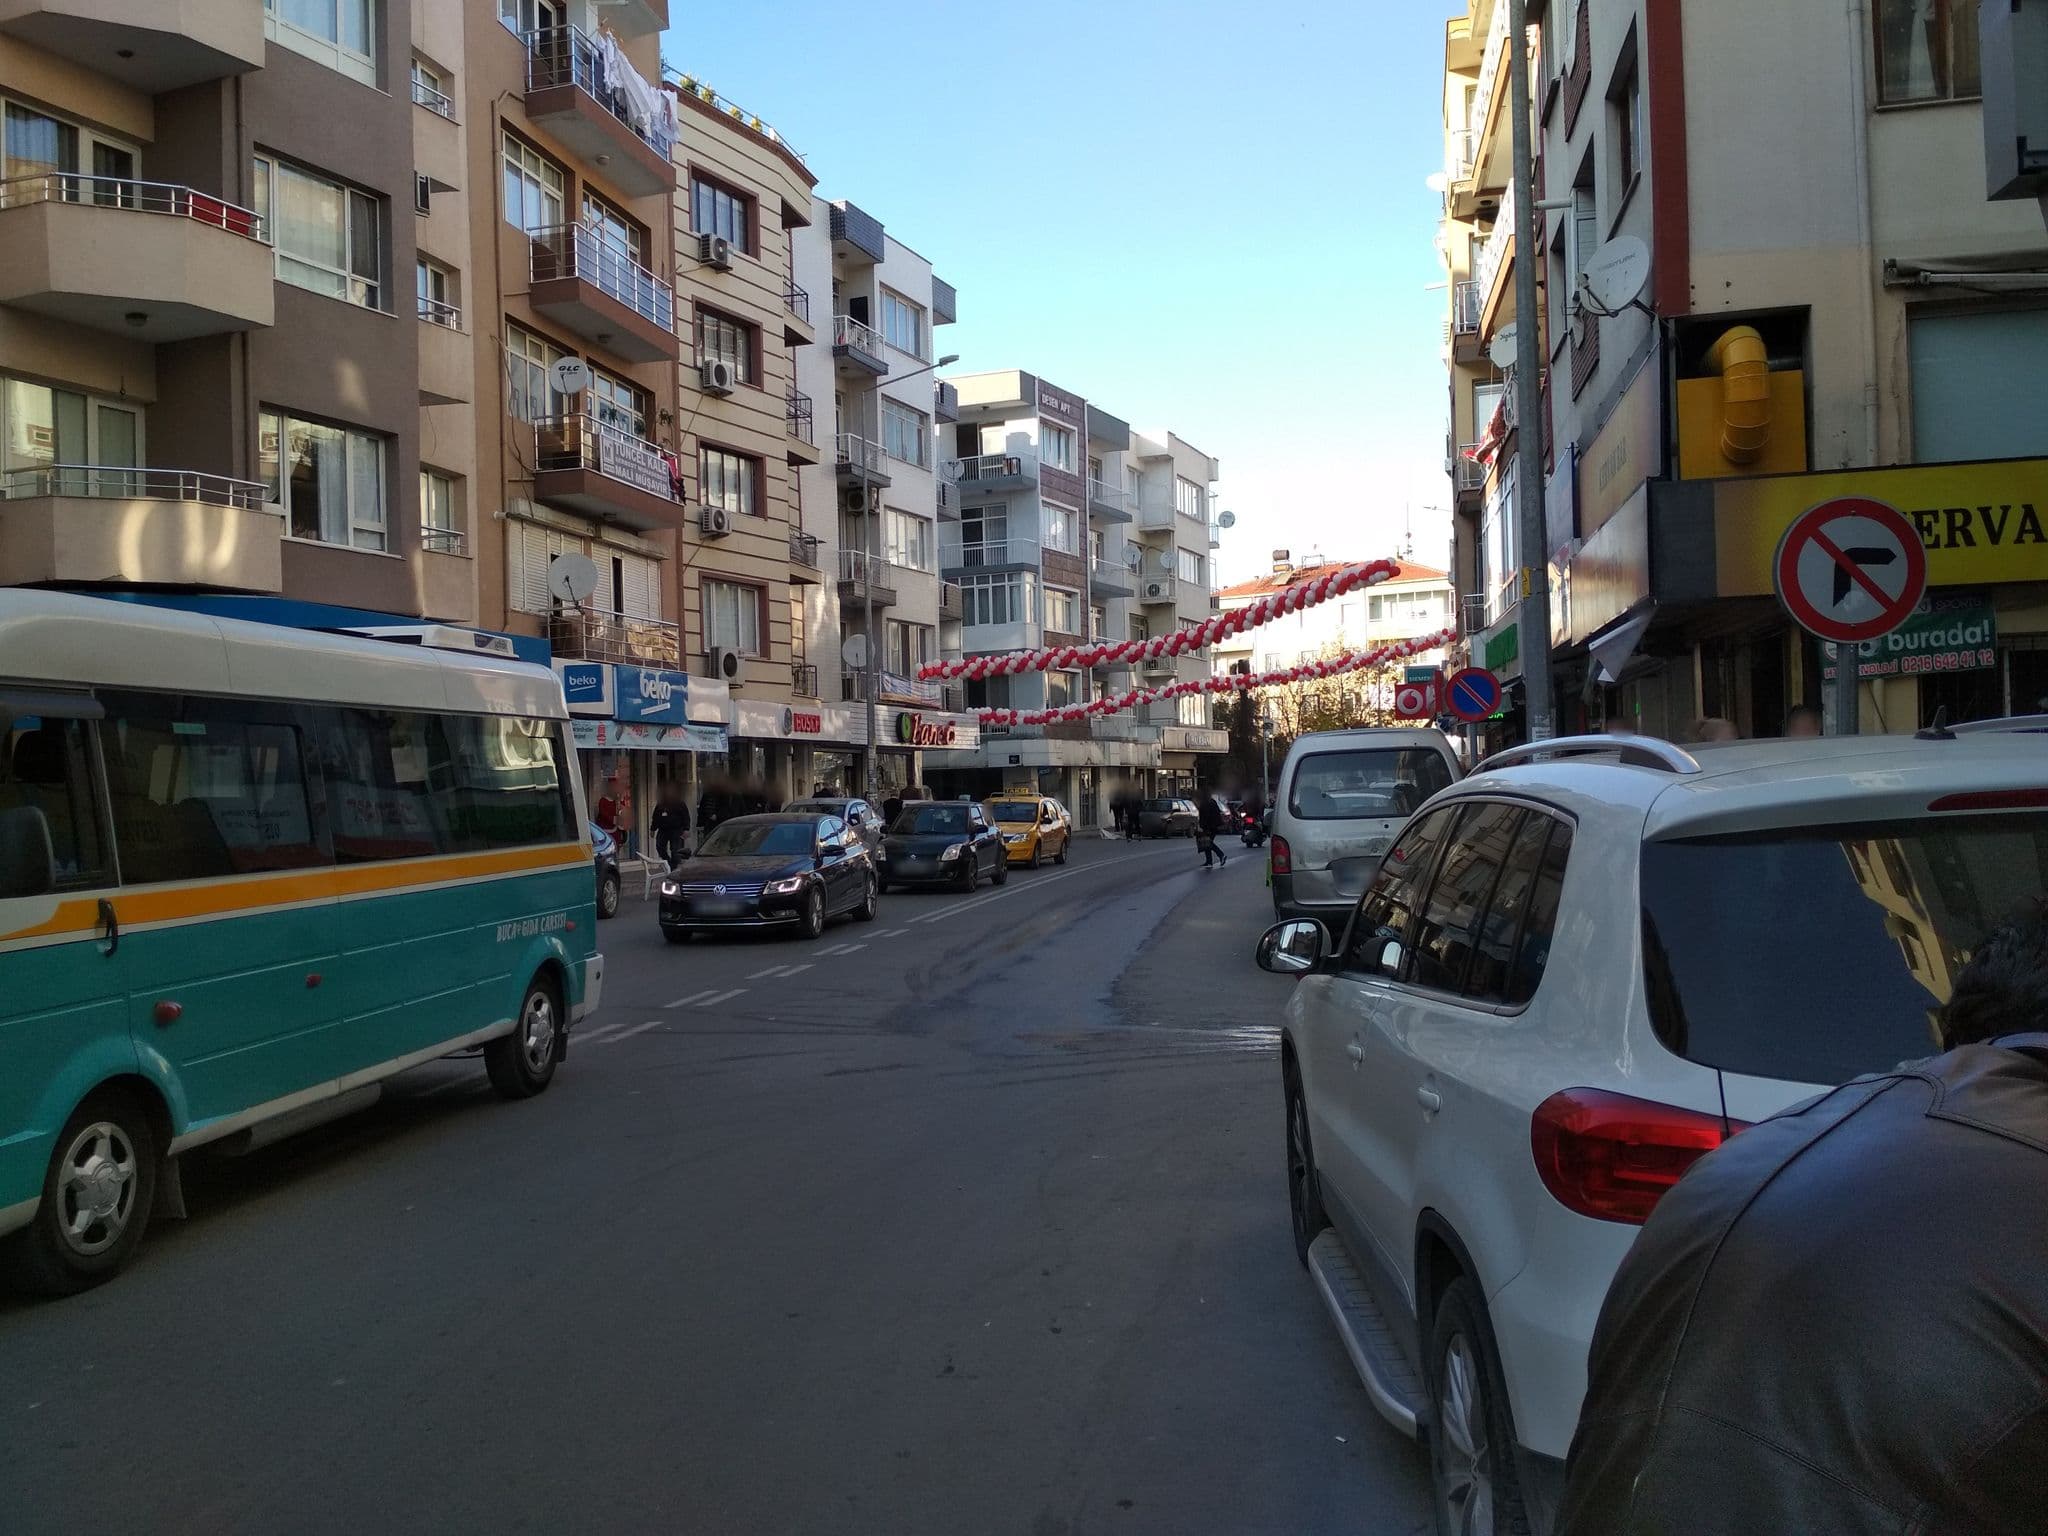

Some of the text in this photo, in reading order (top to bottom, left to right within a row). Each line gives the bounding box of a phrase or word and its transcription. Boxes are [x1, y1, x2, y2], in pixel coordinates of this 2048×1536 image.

[614, 442, 667, 475] TUNCEL KALE
[1903, 504, 2048, 549] ERVA
[1887, 619, 1990, 652] burada!
[1933, 652, 1958, 670] 642
[1977, 648, 1994, 665] 12
[568, 676, 597, 686] beko
[639, 669, 671, 700] beko
[796, 715, 819, 731] BOSCH
[496, 922, 517, 943] BUCA
[521, 918, 539, 936] GIDA
